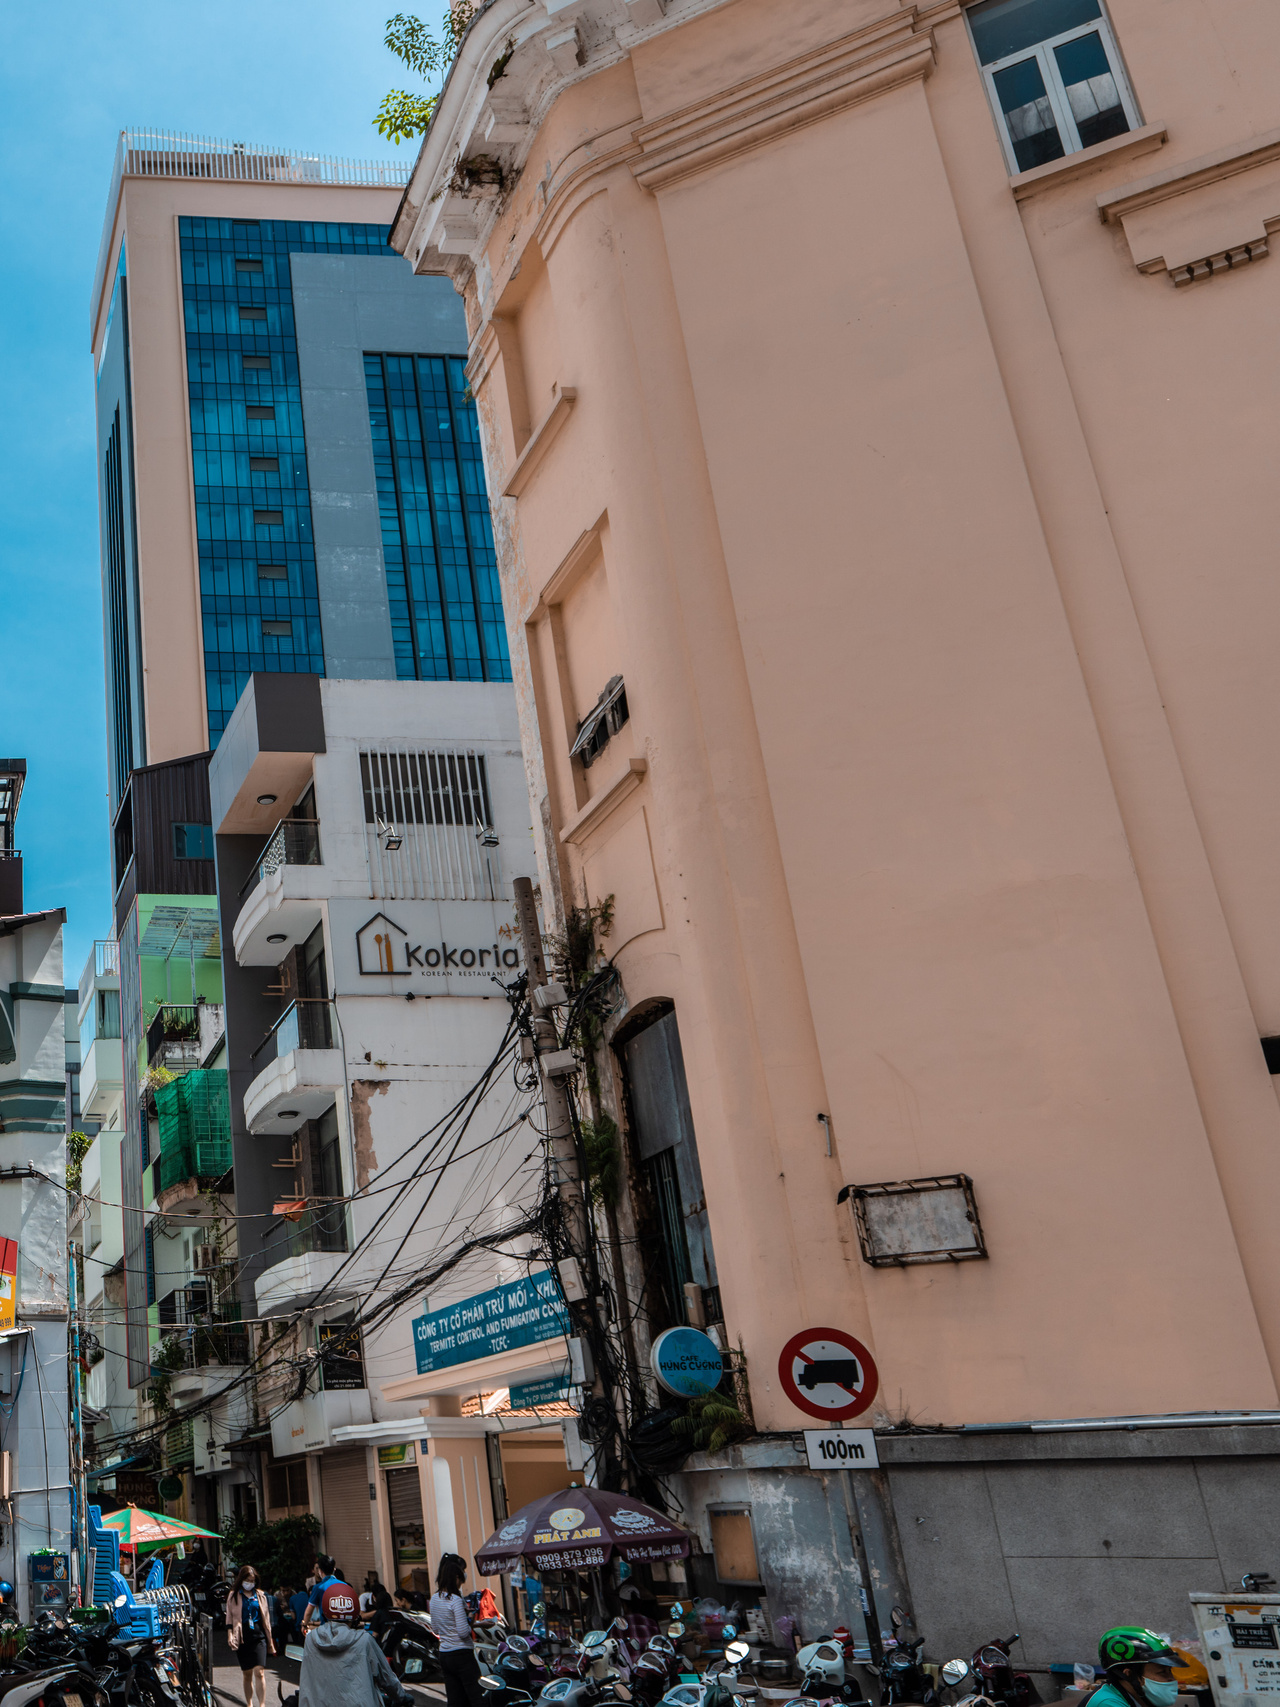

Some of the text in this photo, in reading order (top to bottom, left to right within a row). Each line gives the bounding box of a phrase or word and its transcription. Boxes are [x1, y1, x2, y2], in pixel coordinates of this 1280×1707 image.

[459, 970, 506, 978] RESTAURANT
[417, 1281, 528, 1341] CÔNG TY CỔ PHẦN TRỪ MỐI
[429, 1336, 456, 1355] TERMITE
[456, 1325, 485, 1345] CONTROL
[486, 1321, 501, 1337] AND
[501, 1306, 540, 1332] FUMIGATION
[818, 1440, 865, 1459] 100m
[533, 1530, 570, 1545] PHÁT
[571, 1527, 602, 1541] ANH
[535, 1547, 604, 1564] 0909.879.096
[537, 1555, 605, 1572] 0933.345.886
[330, 1598, 352, 1609] DALLAS
